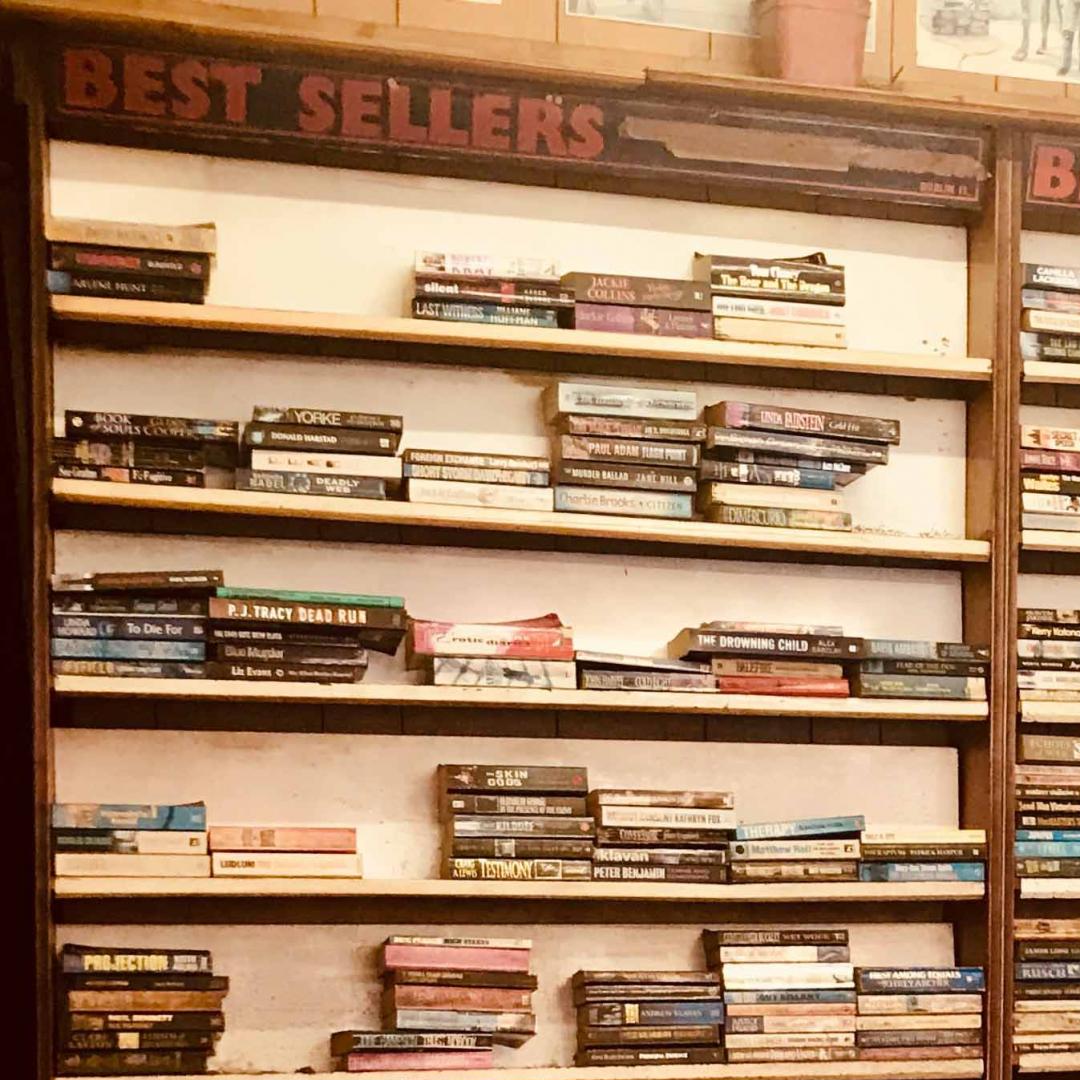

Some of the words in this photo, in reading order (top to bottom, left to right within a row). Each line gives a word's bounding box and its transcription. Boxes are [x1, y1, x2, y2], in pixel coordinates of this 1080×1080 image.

[62, 47, 263, 122] BEST
[298, 73, 605, 158] SELLERS
[587, 289, 636, 301] COLLINS
[295, 410, 342, 425] YORKE
[588, 442, 611, 455] PAUL
[613, 444, 639, 457] ADAM
[316, 477, 361, 488] DEADLY
[254, 605, 293, 622] TRACY
[297, 607, 334, 624] DEAD
[338, 608, 367, 627] RUN
[126, 623, 142, 635] To
[143, 624, 164, 636] Die
[165, 625, 183, 638] For
[1031, 625, 1053, 639] Kerry
[697, 635, 716, 648] THE
[719, 636, 775, 653] DROWNING
[778, 640, 808, 653] CHILD
[246, 667, 272, 679] Evans
[495, 770, 528, 780] SKIN
[480, 860, 534, 879] TESTIMONY
[594, 867, 621, 879] PETER
